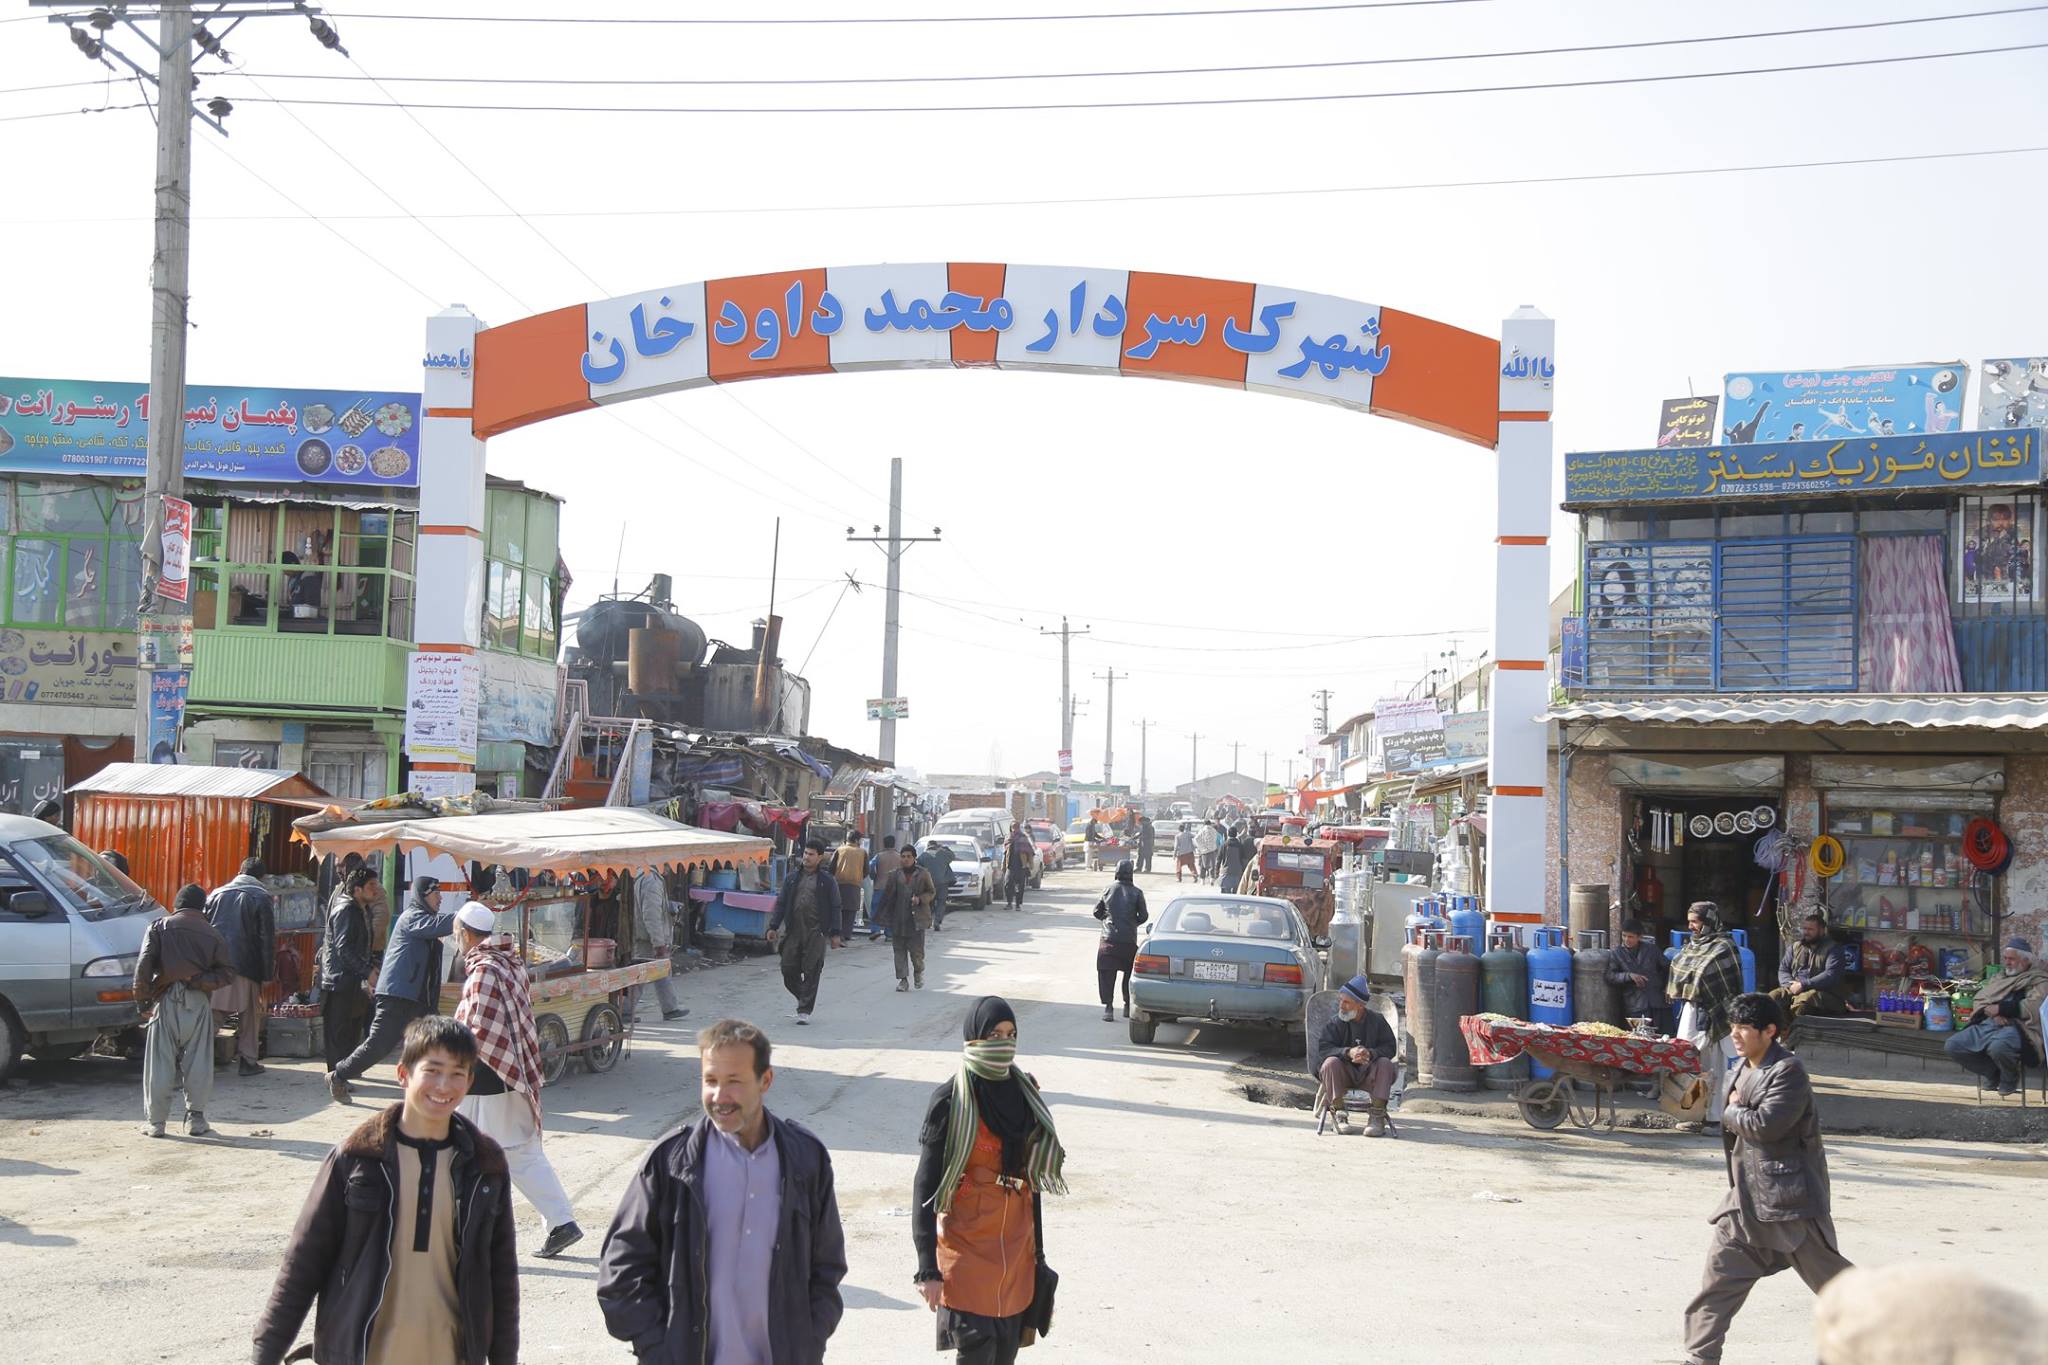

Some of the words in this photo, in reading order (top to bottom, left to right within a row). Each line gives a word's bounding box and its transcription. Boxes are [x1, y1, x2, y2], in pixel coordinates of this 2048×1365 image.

[714, 279, 845, 360] داود
[863, 288, 1015, 335] محمد
[1025, 279, 1207, 361] سردار
[422, 351, 458, 368] محمد
[581, 295, 697, 385] خان
[1222, 300, 1391, 381] شهرک
[15, 388, 130, 428] رستورانت
[184, 396, 218, 430] نمب
[221, 397, 298, 436] پغمان
[1666, 413, 1706, 428] فوتوکاپی
[1670, 399, 1708, 413] عکاسی
[1938, 433, 2031, 480] افغان
[1552, 994, 1564, 1004] 45
